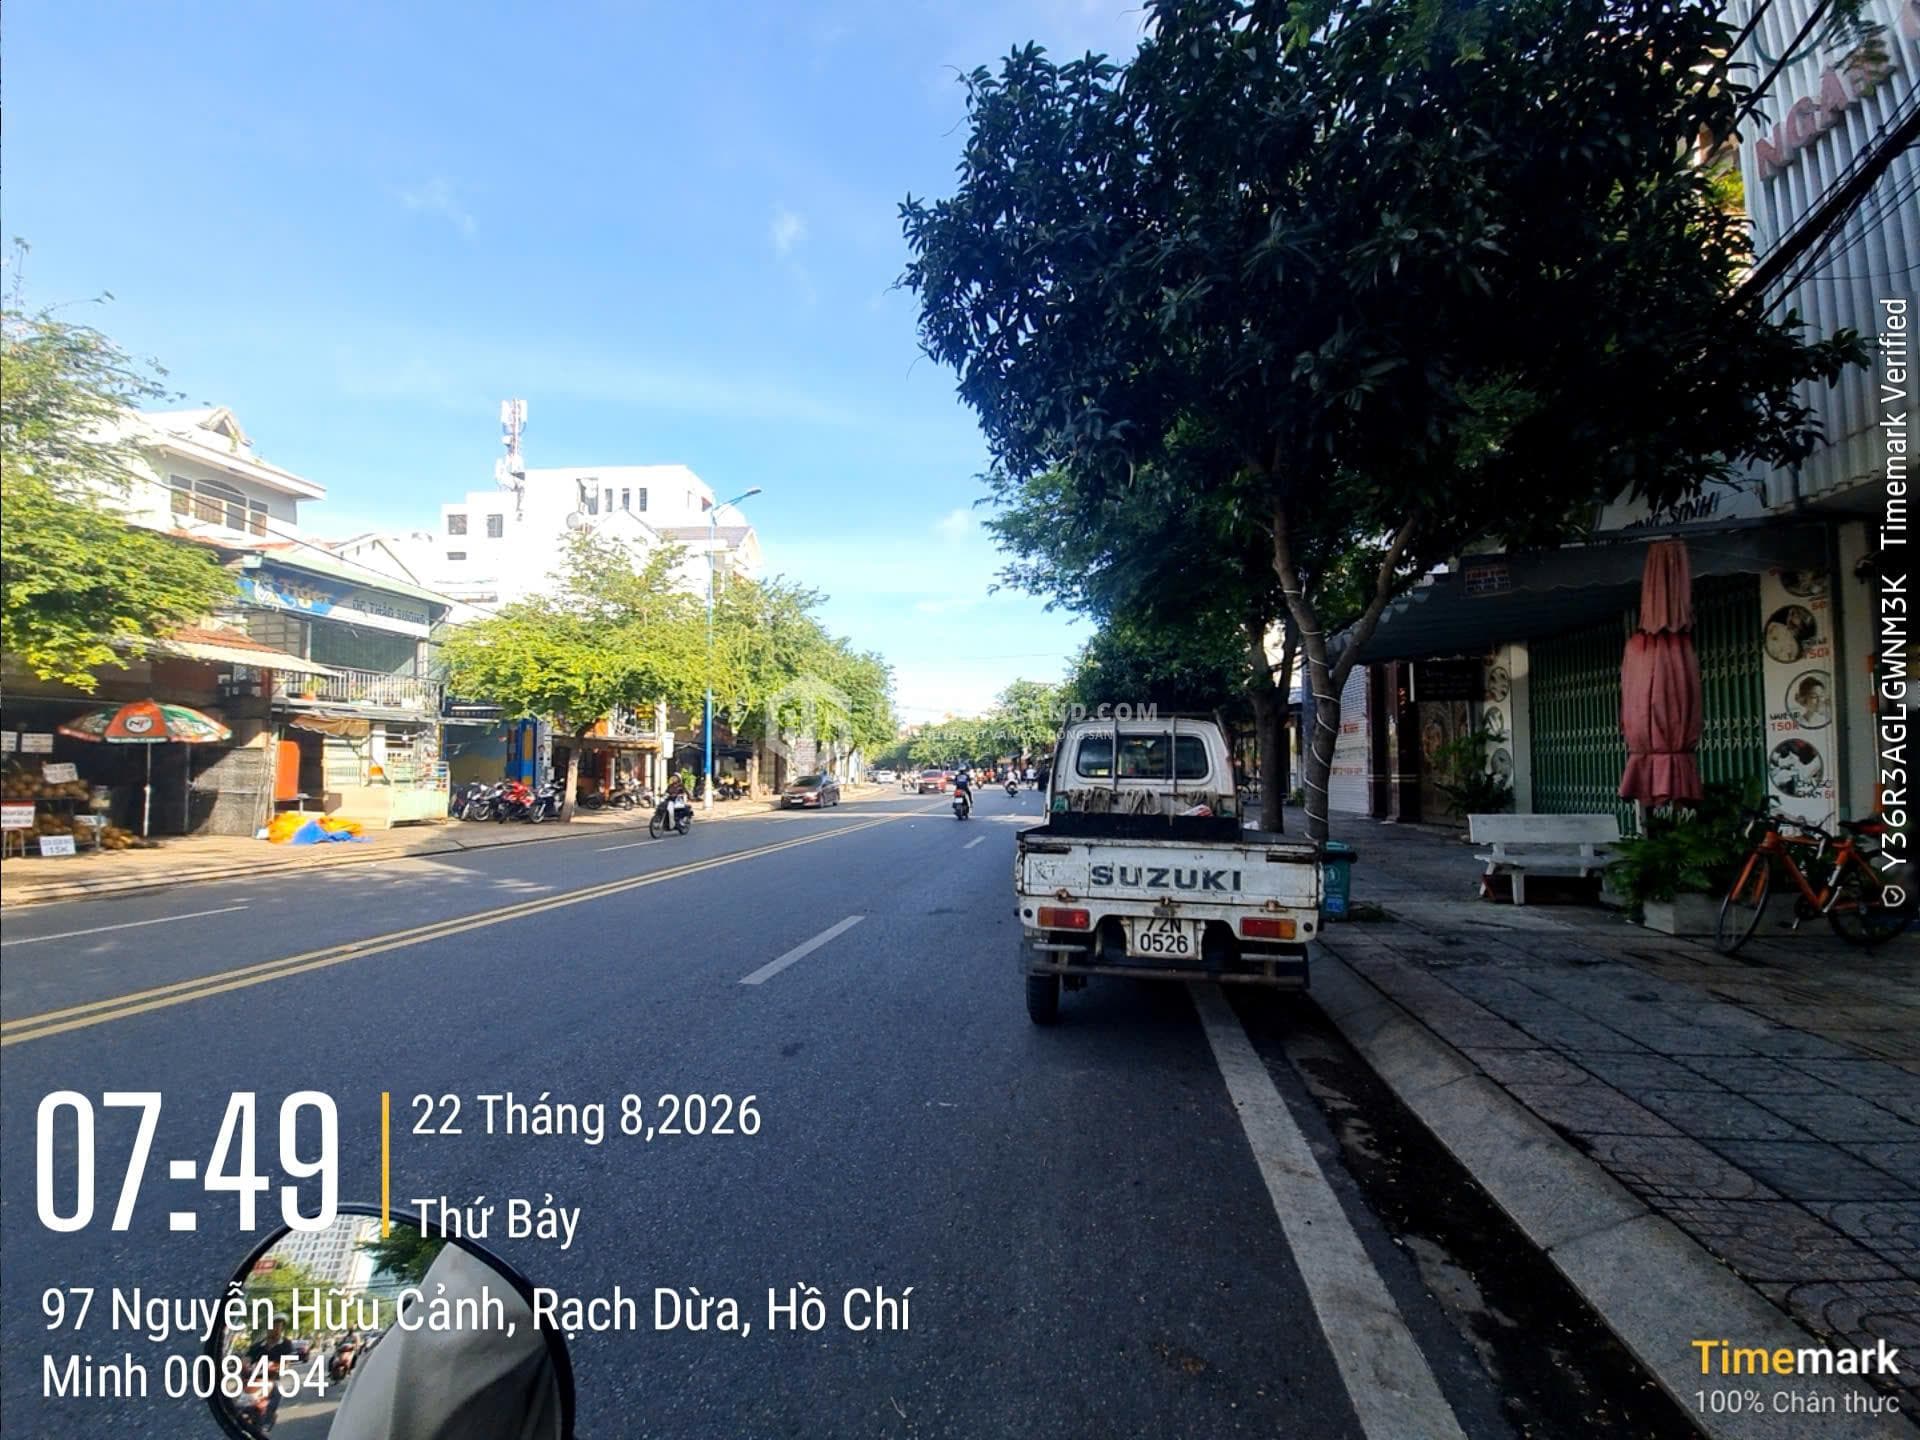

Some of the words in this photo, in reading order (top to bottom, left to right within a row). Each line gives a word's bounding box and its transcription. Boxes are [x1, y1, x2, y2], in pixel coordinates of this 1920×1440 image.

[1091, 864, 1242, 891] SUZUKI
[1147, 917, 1182, 933] 72N
[1140, 933, 1188, 953] 0526
